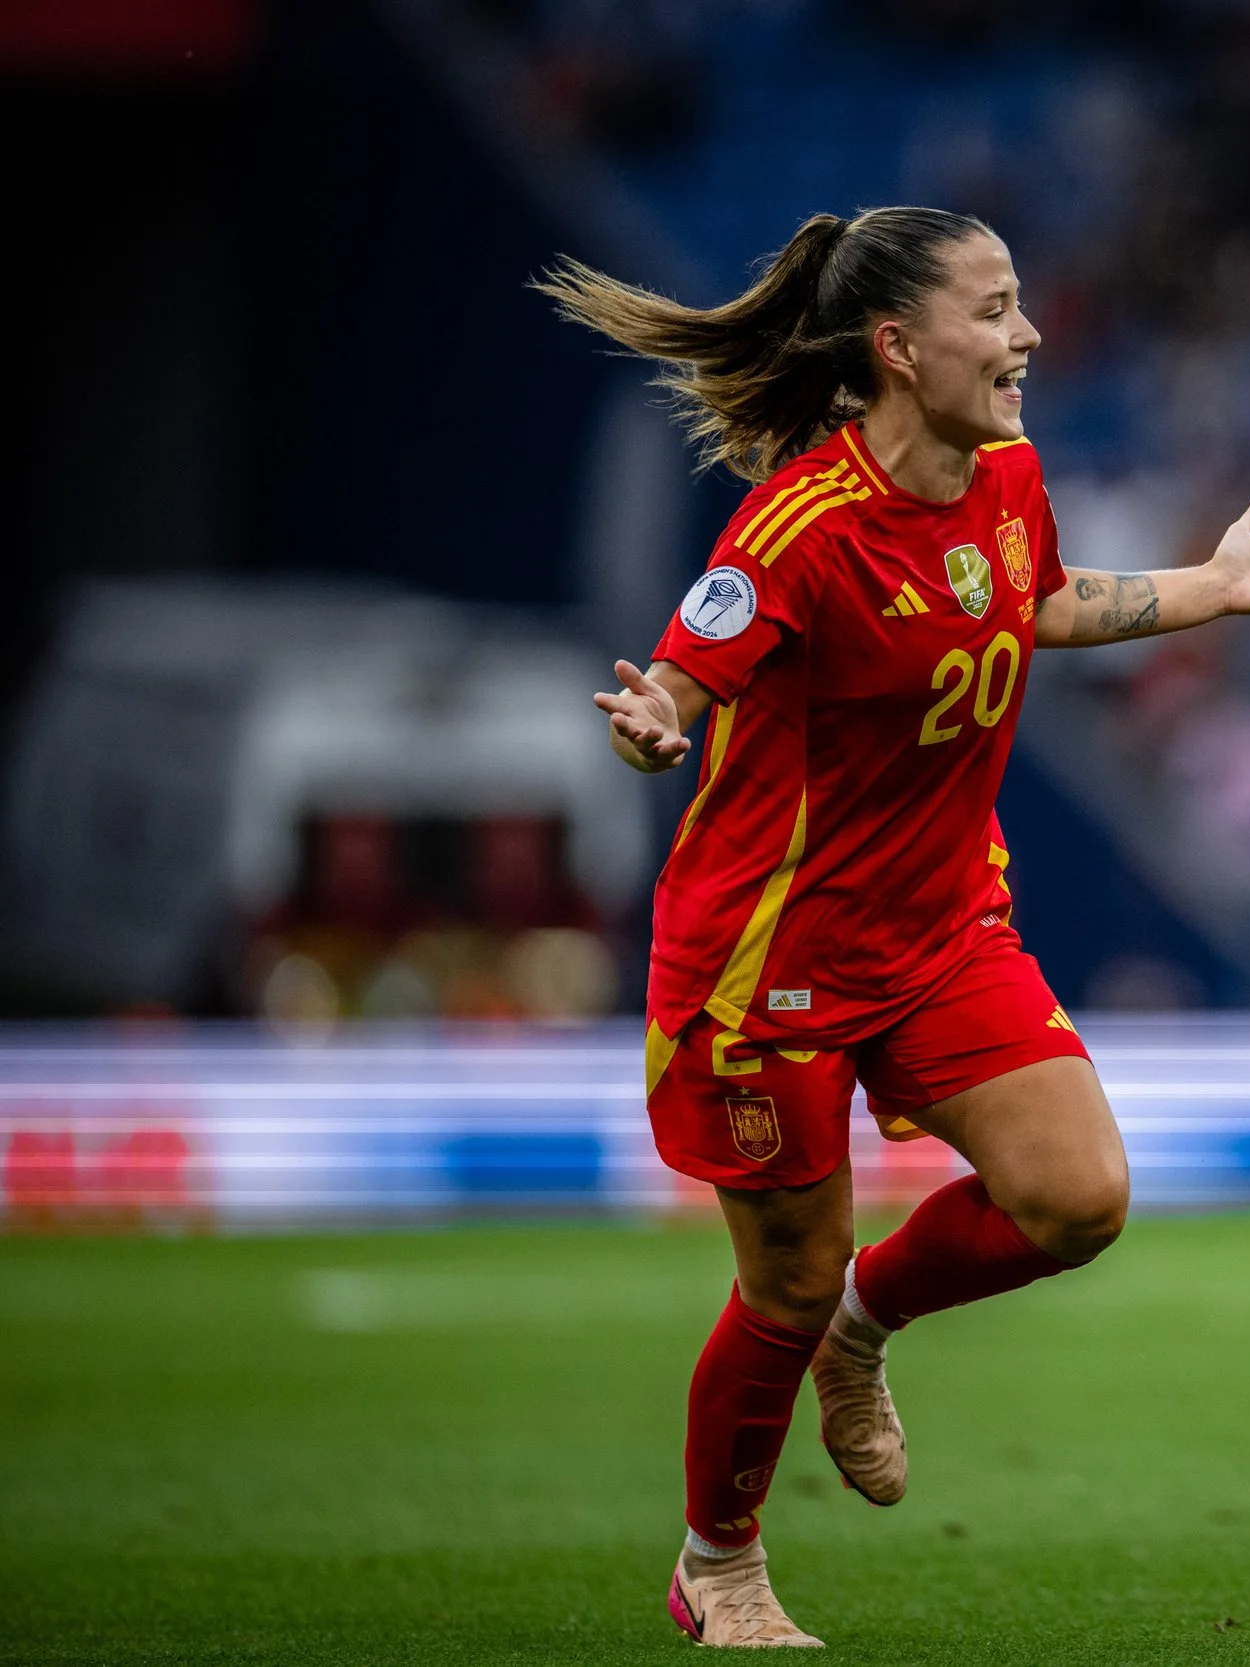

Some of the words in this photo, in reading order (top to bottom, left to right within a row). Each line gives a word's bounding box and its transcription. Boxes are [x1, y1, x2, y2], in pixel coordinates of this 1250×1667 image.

[709, 568, 733, 576] WOMEN'S
[733, 571, 752, 592] NATIONS
[969, 588, 985, 602] FIFA
[685, 616, 702, 633] WINNER
[918, 631, 1020, 746] 20
